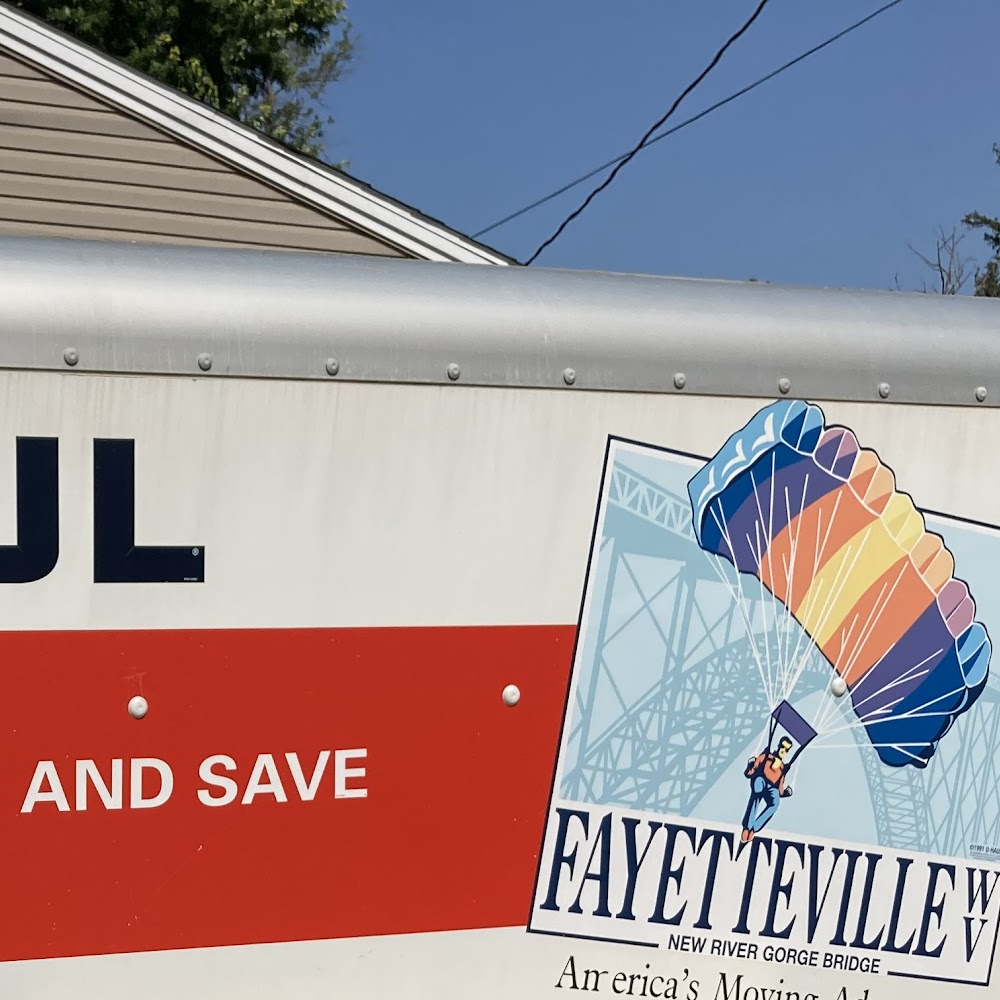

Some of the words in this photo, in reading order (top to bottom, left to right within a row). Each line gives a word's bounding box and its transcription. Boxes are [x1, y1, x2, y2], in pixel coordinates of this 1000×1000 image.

[20, 757, 174, 813] AND
[196, 748, 367, 807] SAVE
[539, 807, 956, 958] FAYETTEVILLE
[668, 934, 707, 953] NEW
[710, 939, 759, 960] RIVER
[763, 945, 819, 967] GORGE
[823, 952, 881, 974] BRIDGE
